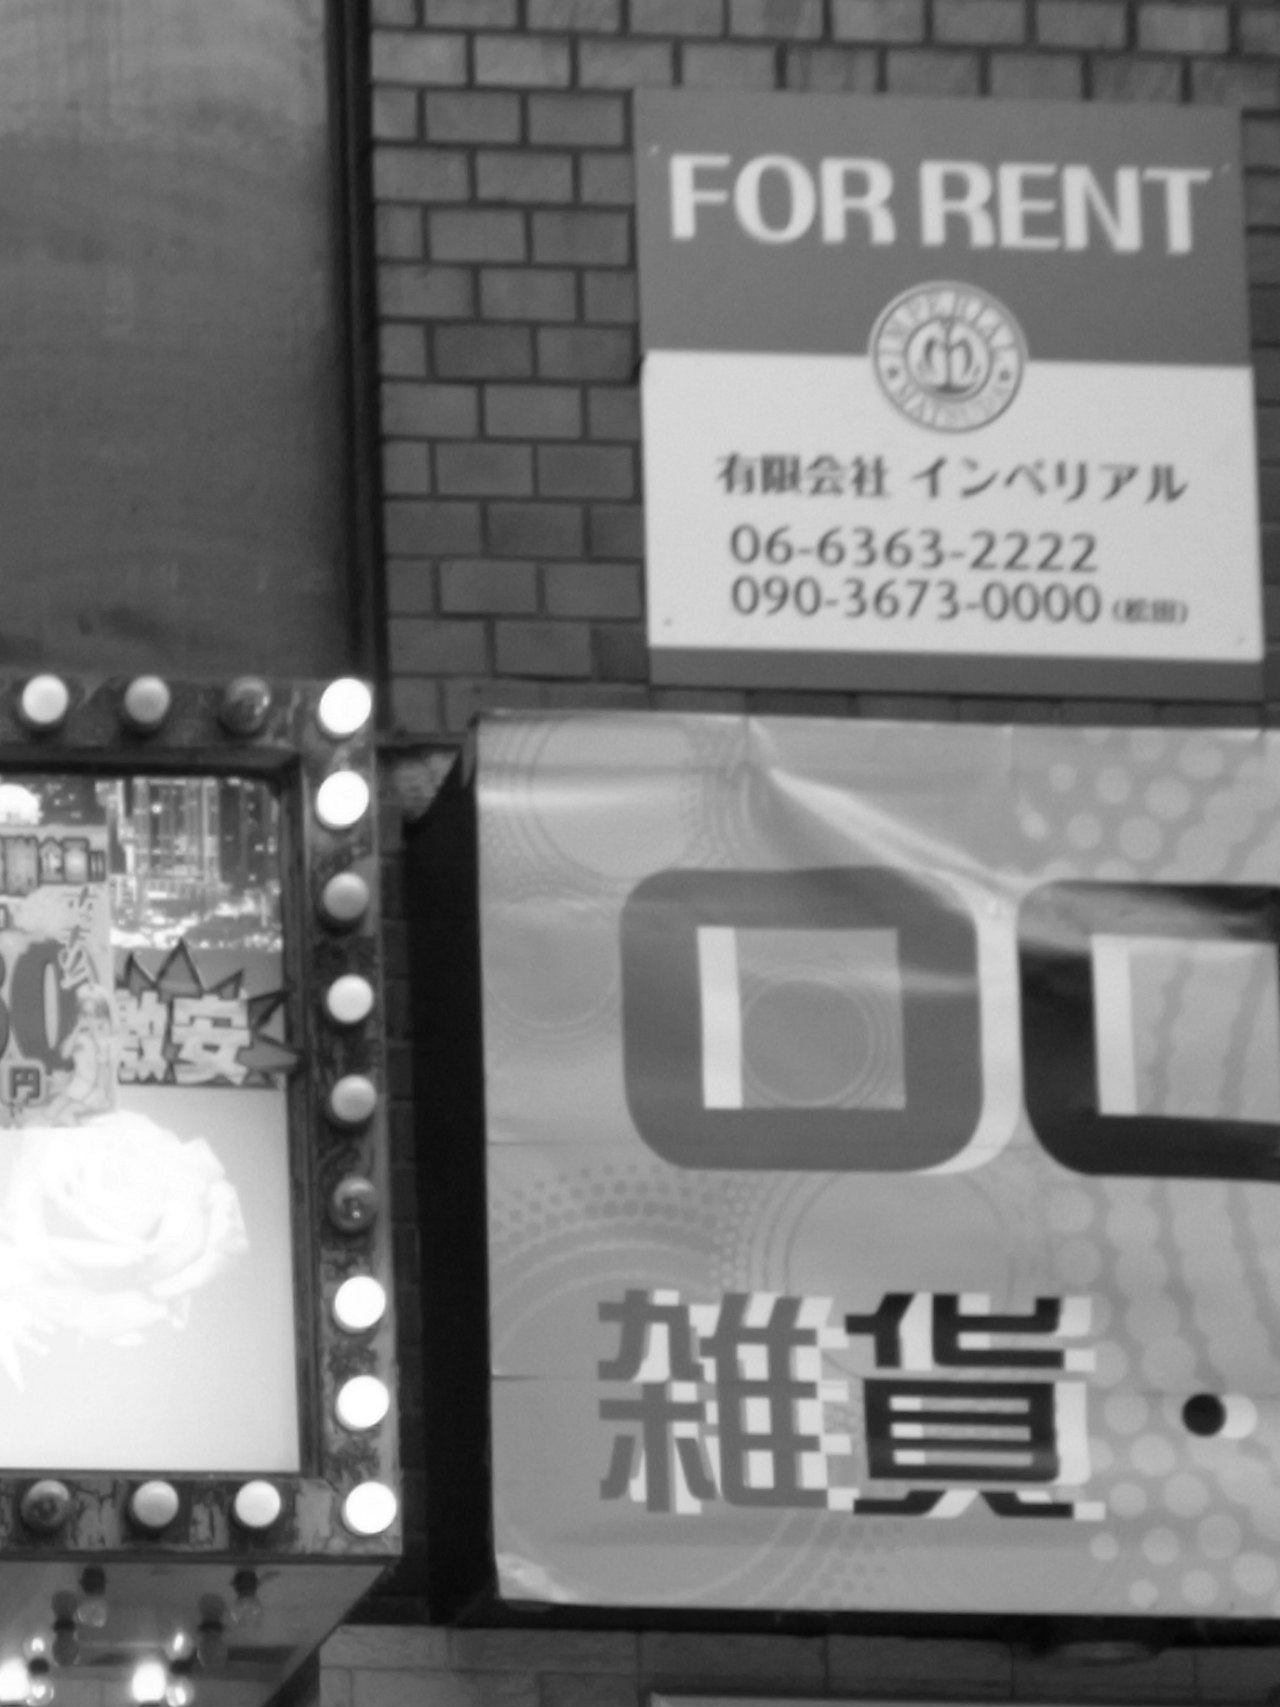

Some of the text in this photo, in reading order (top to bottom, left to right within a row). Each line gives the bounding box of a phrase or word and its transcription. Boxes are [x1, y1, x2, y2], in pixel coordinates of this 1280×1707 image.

[669, 153, 1212, 256] FOR RENT
[716, 454, 1189, 505] 有限会社 インペリアル
[730, 525, 1099, 574] 06-6363-2222
[730, 576, 1102, 624] 090-3673-0000
